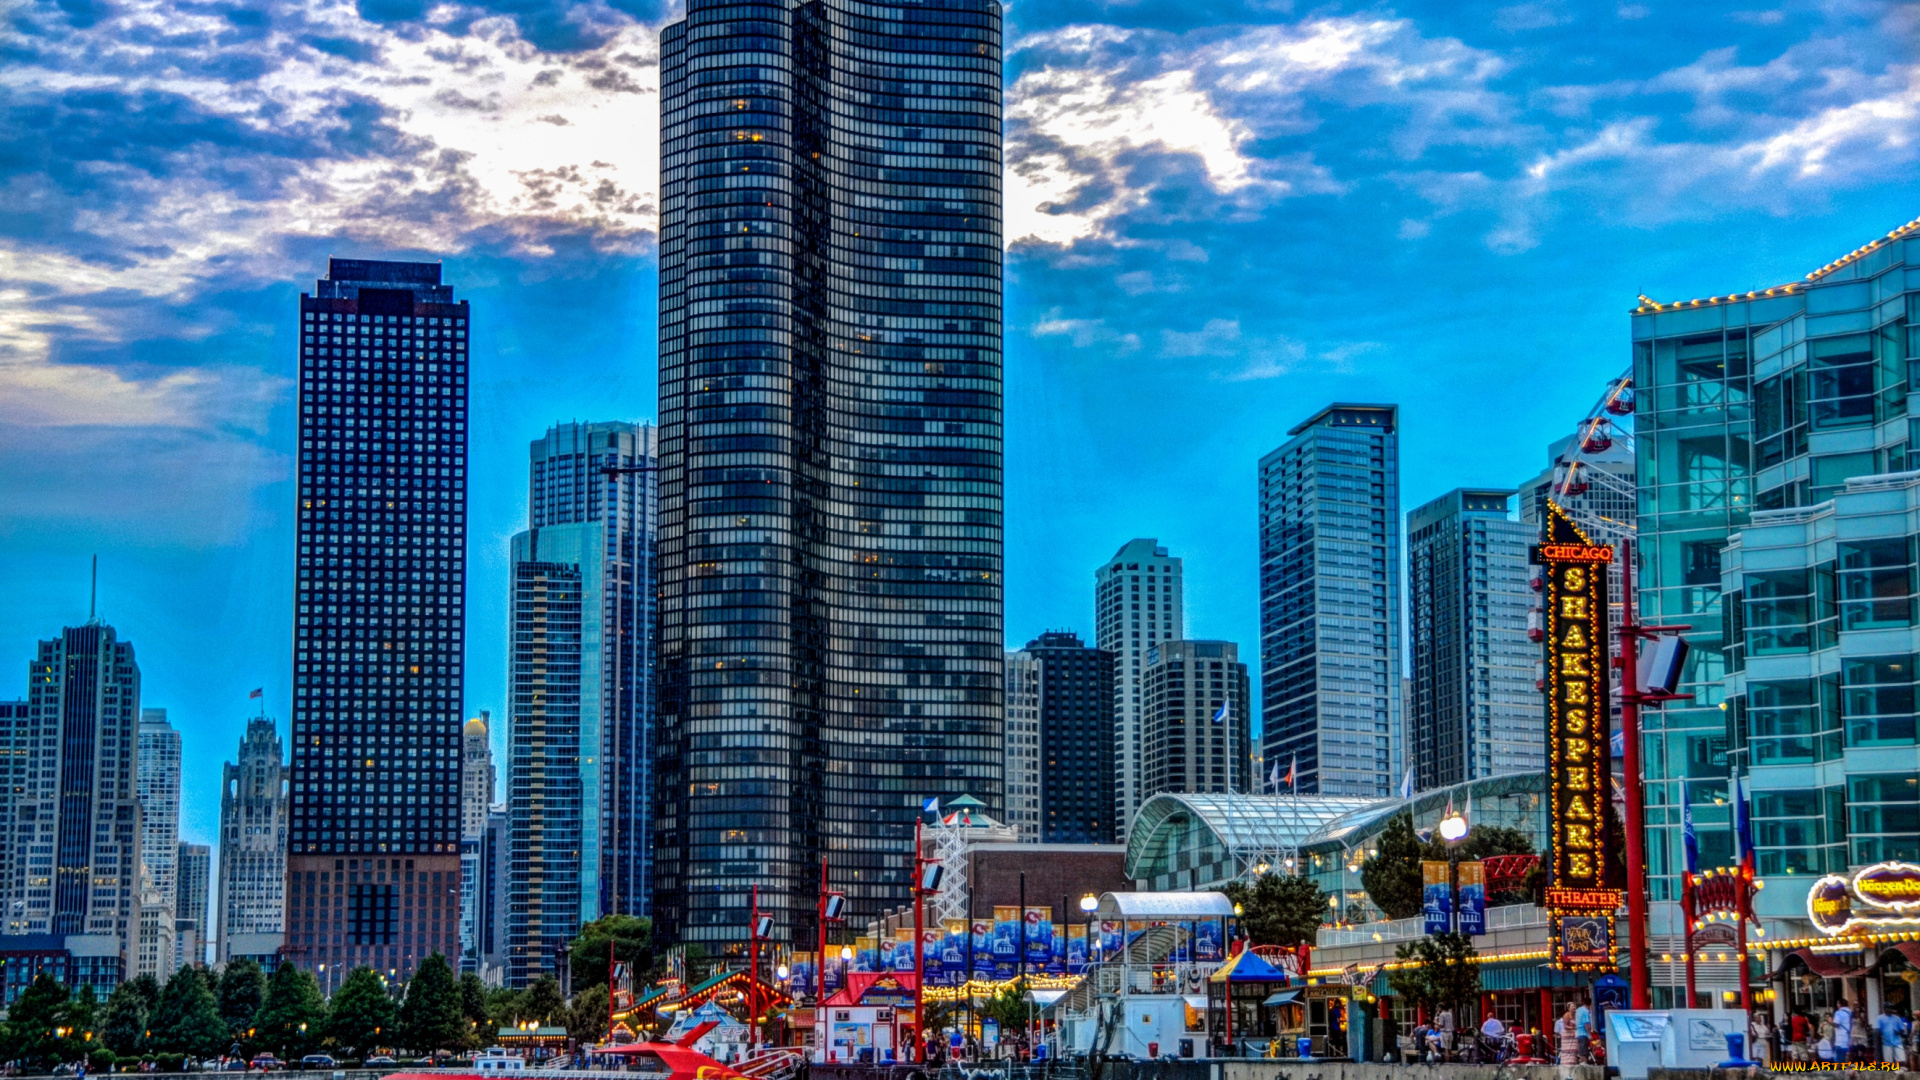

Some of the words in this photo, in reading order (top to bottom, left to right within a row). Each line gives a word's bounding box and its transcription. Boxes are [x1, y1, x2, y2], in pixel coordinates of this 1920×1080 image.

[1544, 546, 1611, 560] CHICAGO
[1562, 567, 1592, 879] SHAKESPEARE
[1549, 891, 1618, 905] THEATER
